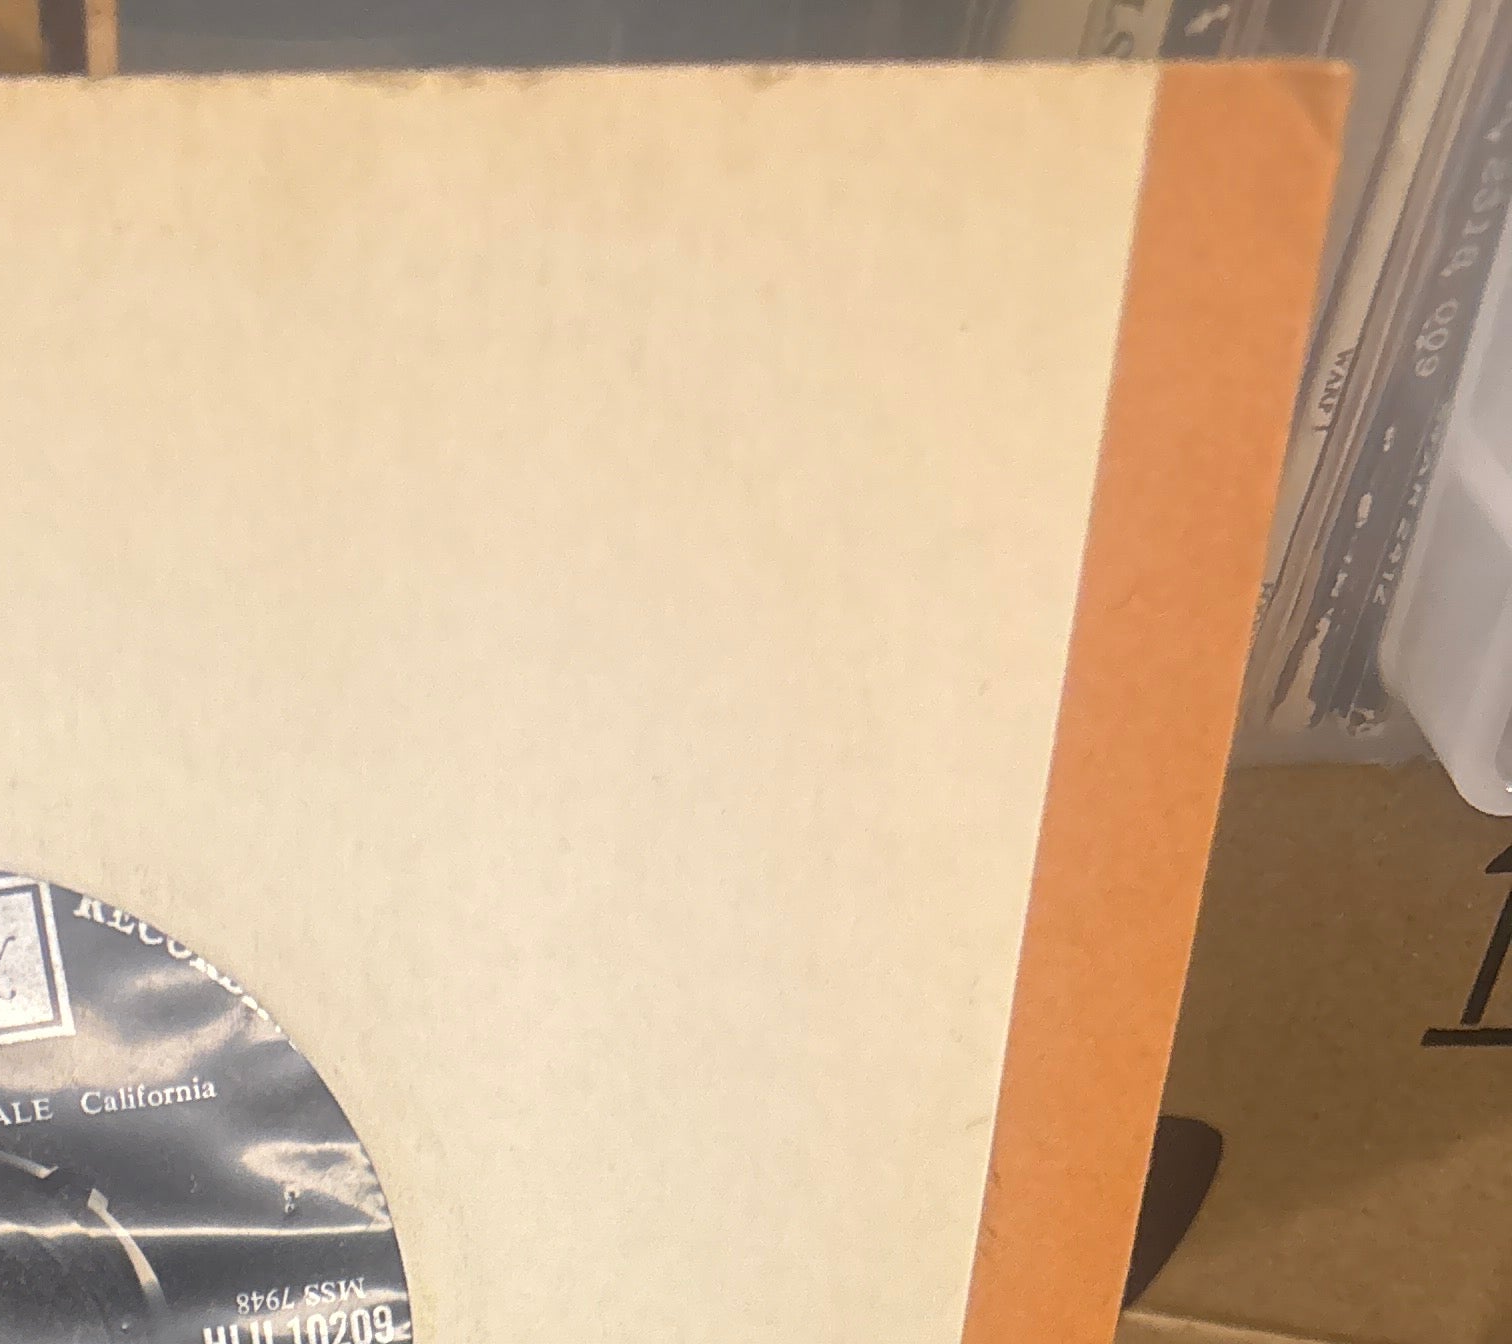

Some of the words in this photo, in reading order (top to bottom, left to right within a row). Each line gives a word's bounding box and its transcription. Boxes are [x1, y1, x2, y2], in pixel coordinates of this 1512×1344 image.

[80, 1077, 217, 1116] California
[236, 1286, 295, 1315] 7948
[304, 1277, 366, 1306] MSS
